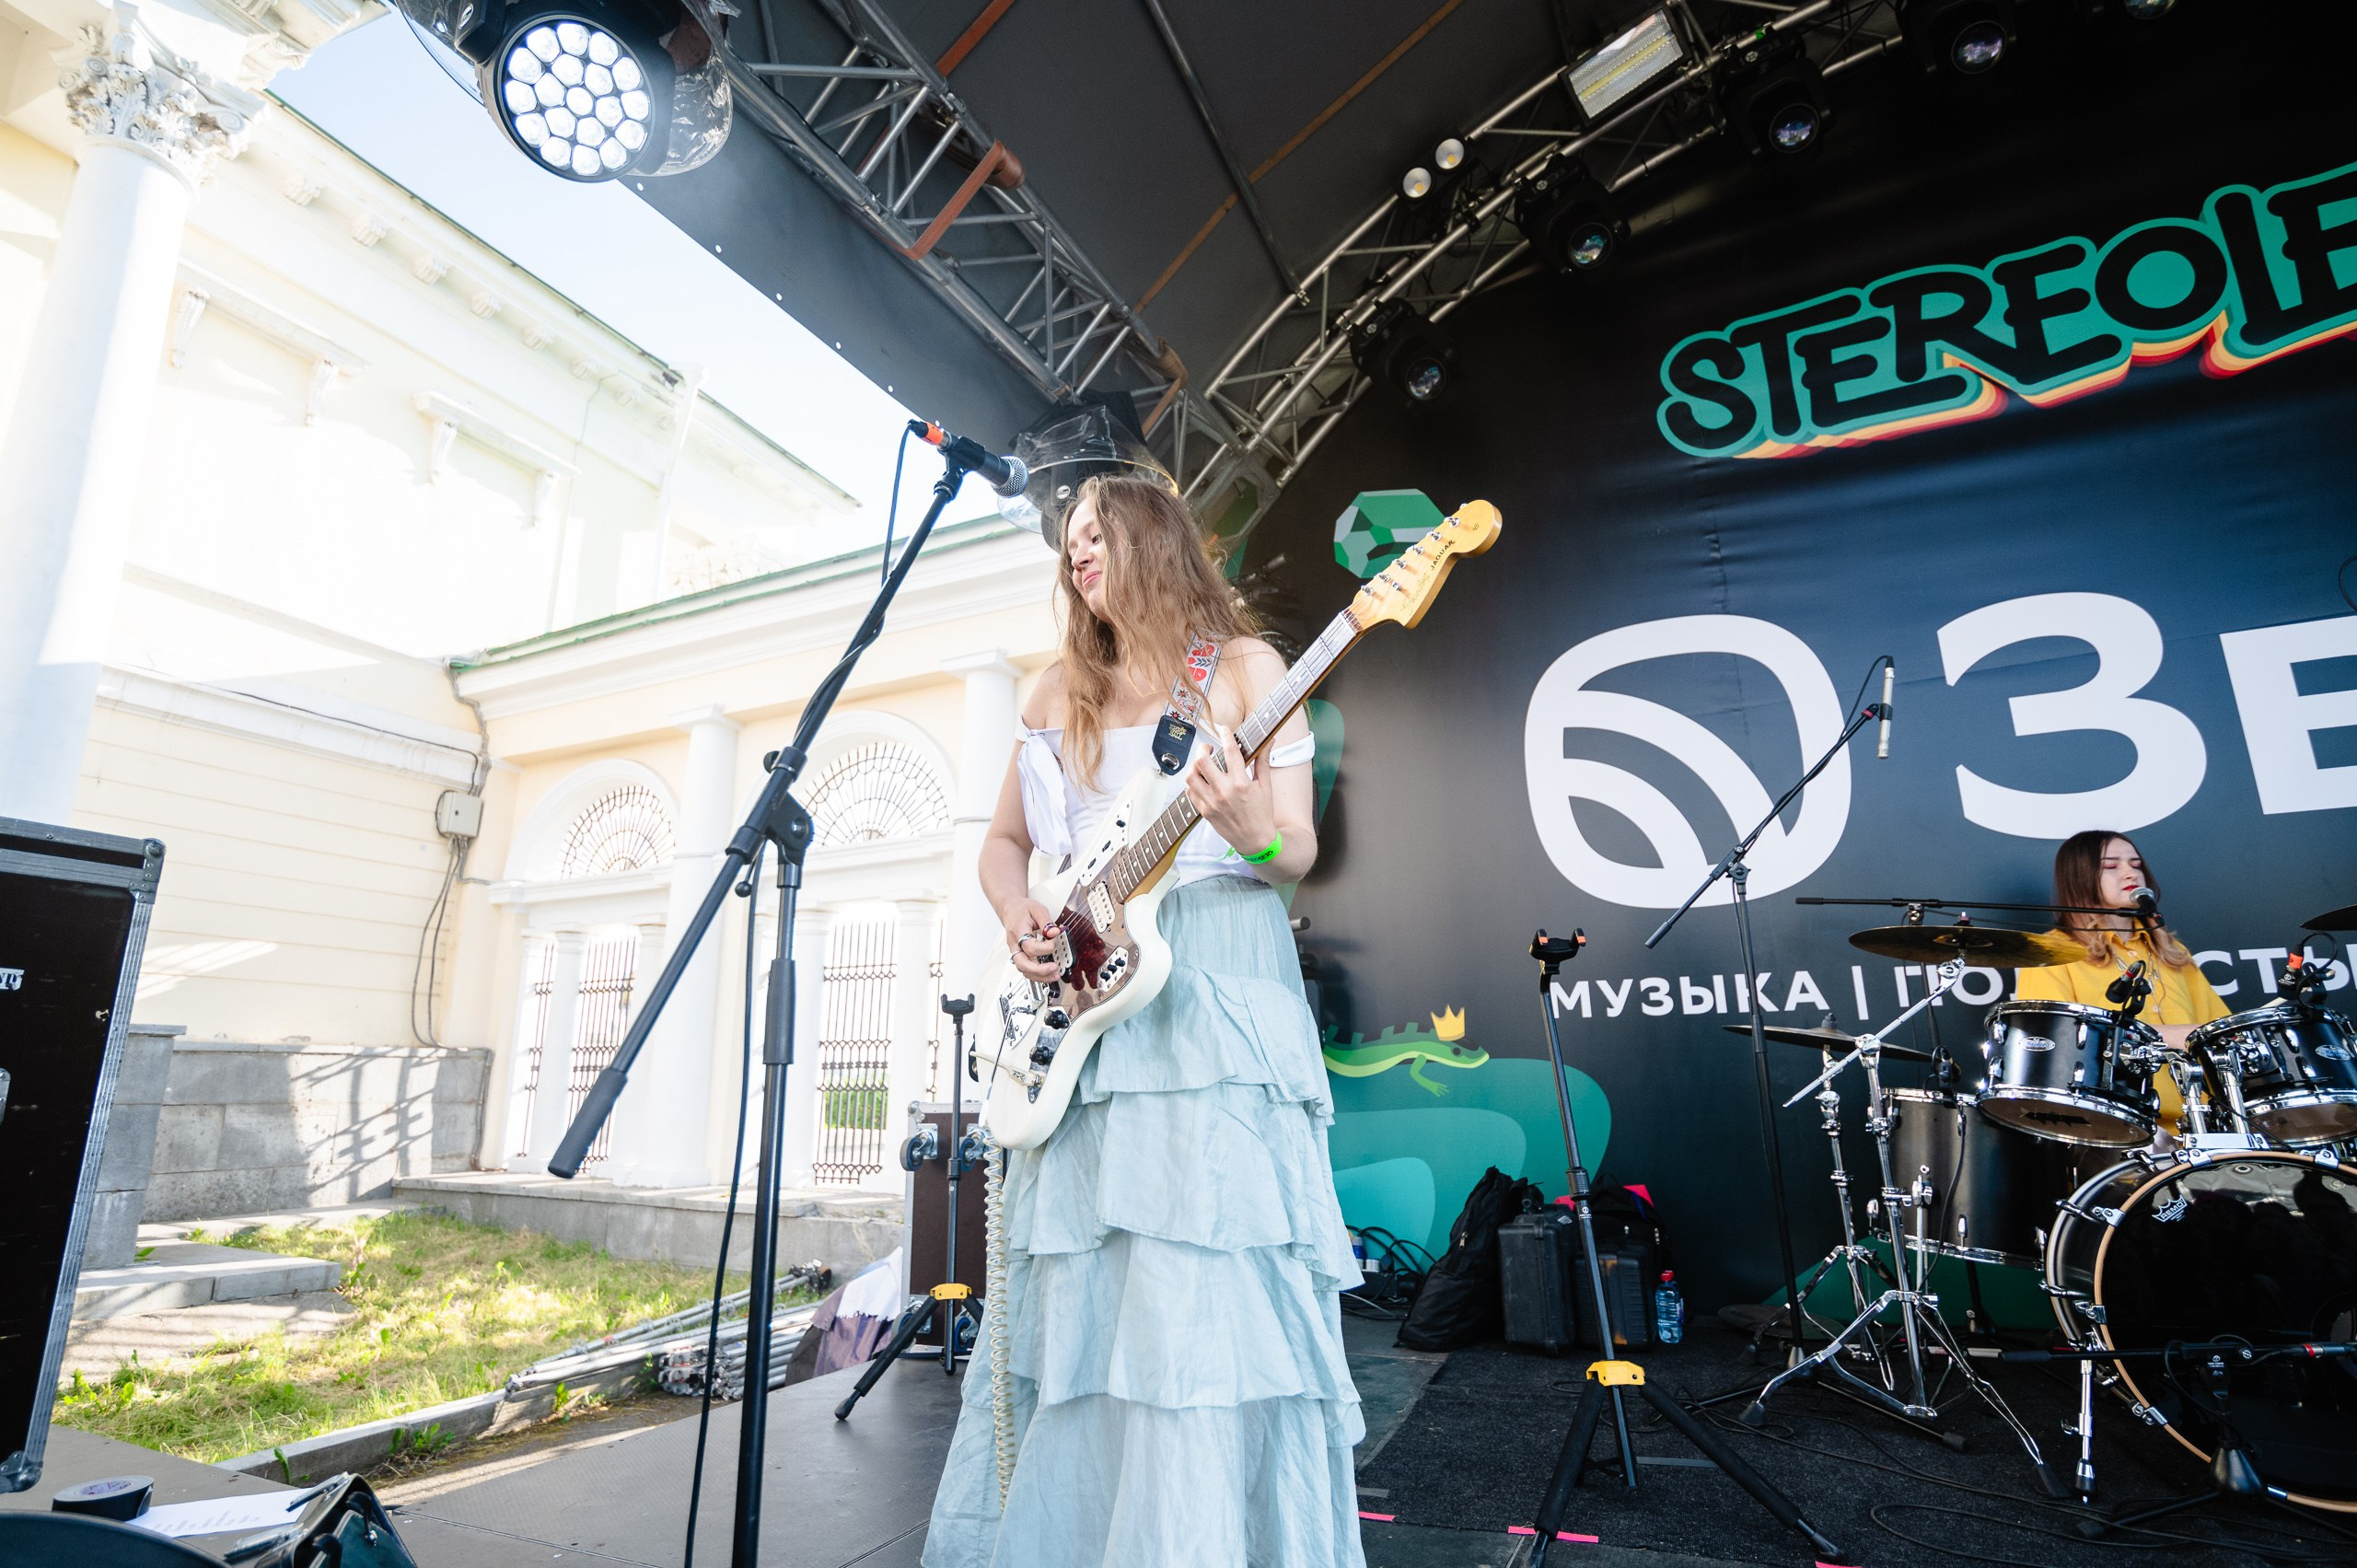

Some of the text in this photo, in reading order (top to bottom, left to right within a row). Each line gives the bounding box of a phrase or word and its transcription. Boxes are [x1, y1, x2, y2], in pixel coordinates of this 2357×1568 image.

[1431, 540, 1456, 571] JAGUAR
[1550, 970, 1830, 1018] МУЗЫКА
[2160, 1202, 2184, 1219] REMO
